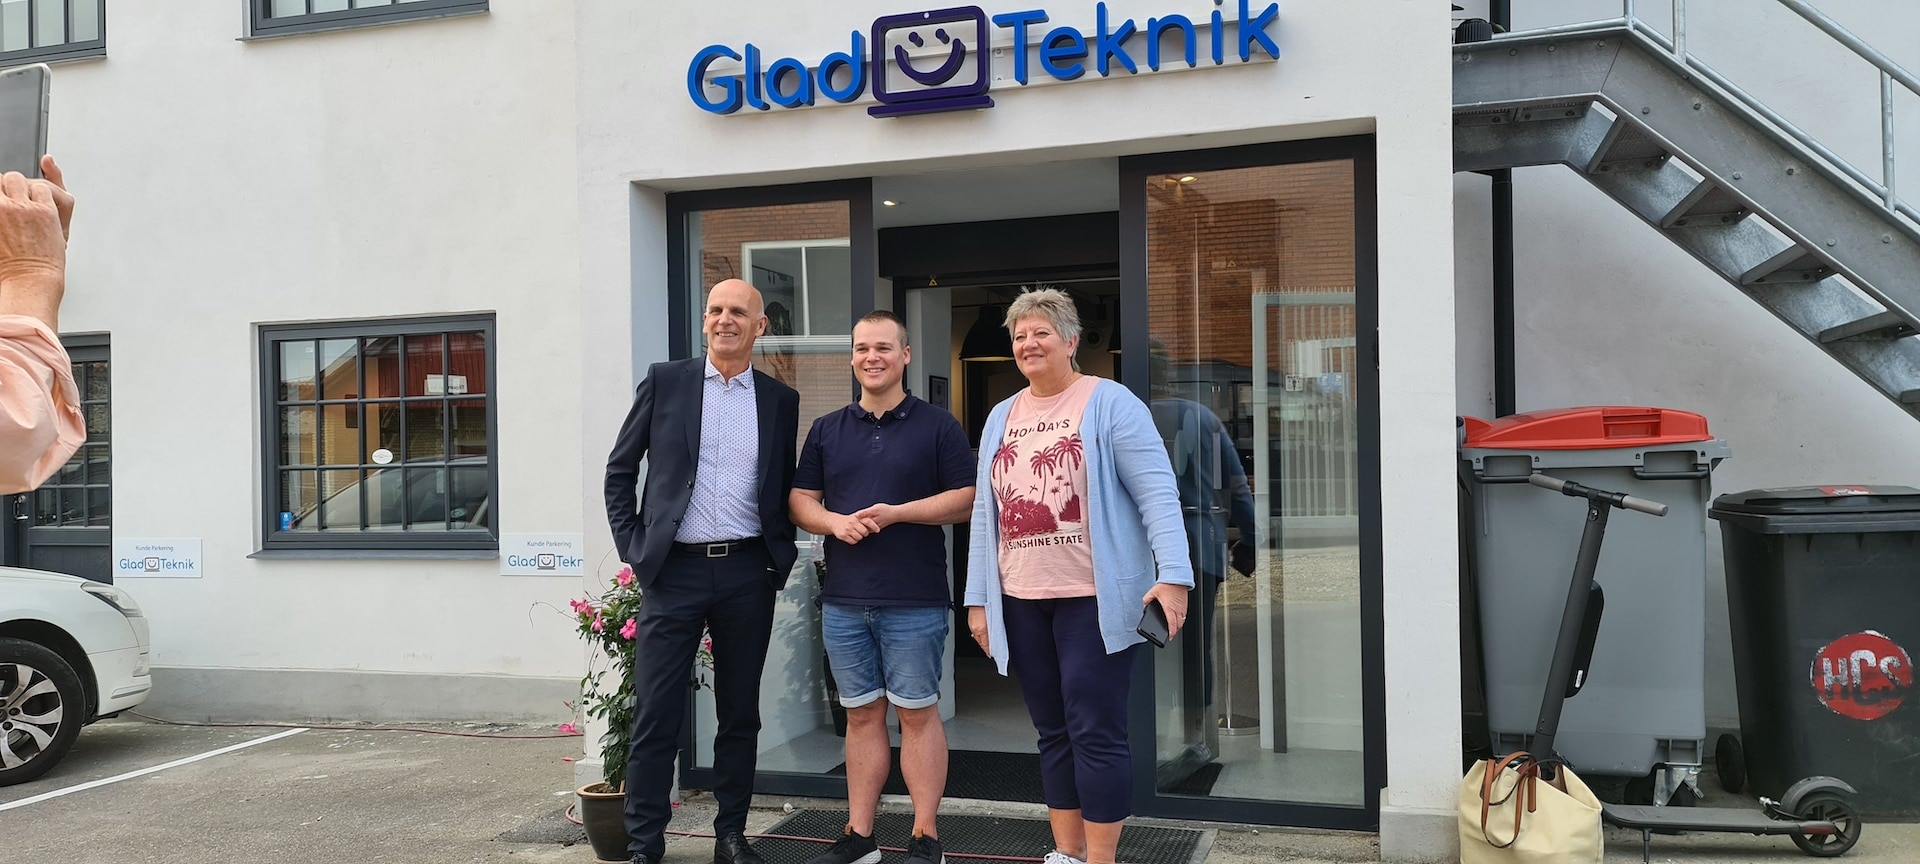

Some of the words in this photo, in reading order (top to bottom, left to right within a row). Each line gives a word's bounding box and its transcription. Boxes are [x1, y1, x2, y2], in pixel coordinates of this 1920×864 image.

[687, 30, 868, 116] Glad
[992, 0, 1281, 85] Teknik
[1008, 537, 1051, 550] SUNSHINE
[1054, 534, 1083, 545] STATE
[119, 559, 144, 570] Glad
[160, 559, 194, 570] Teknik
[508, 555, 537, 567] Glad
